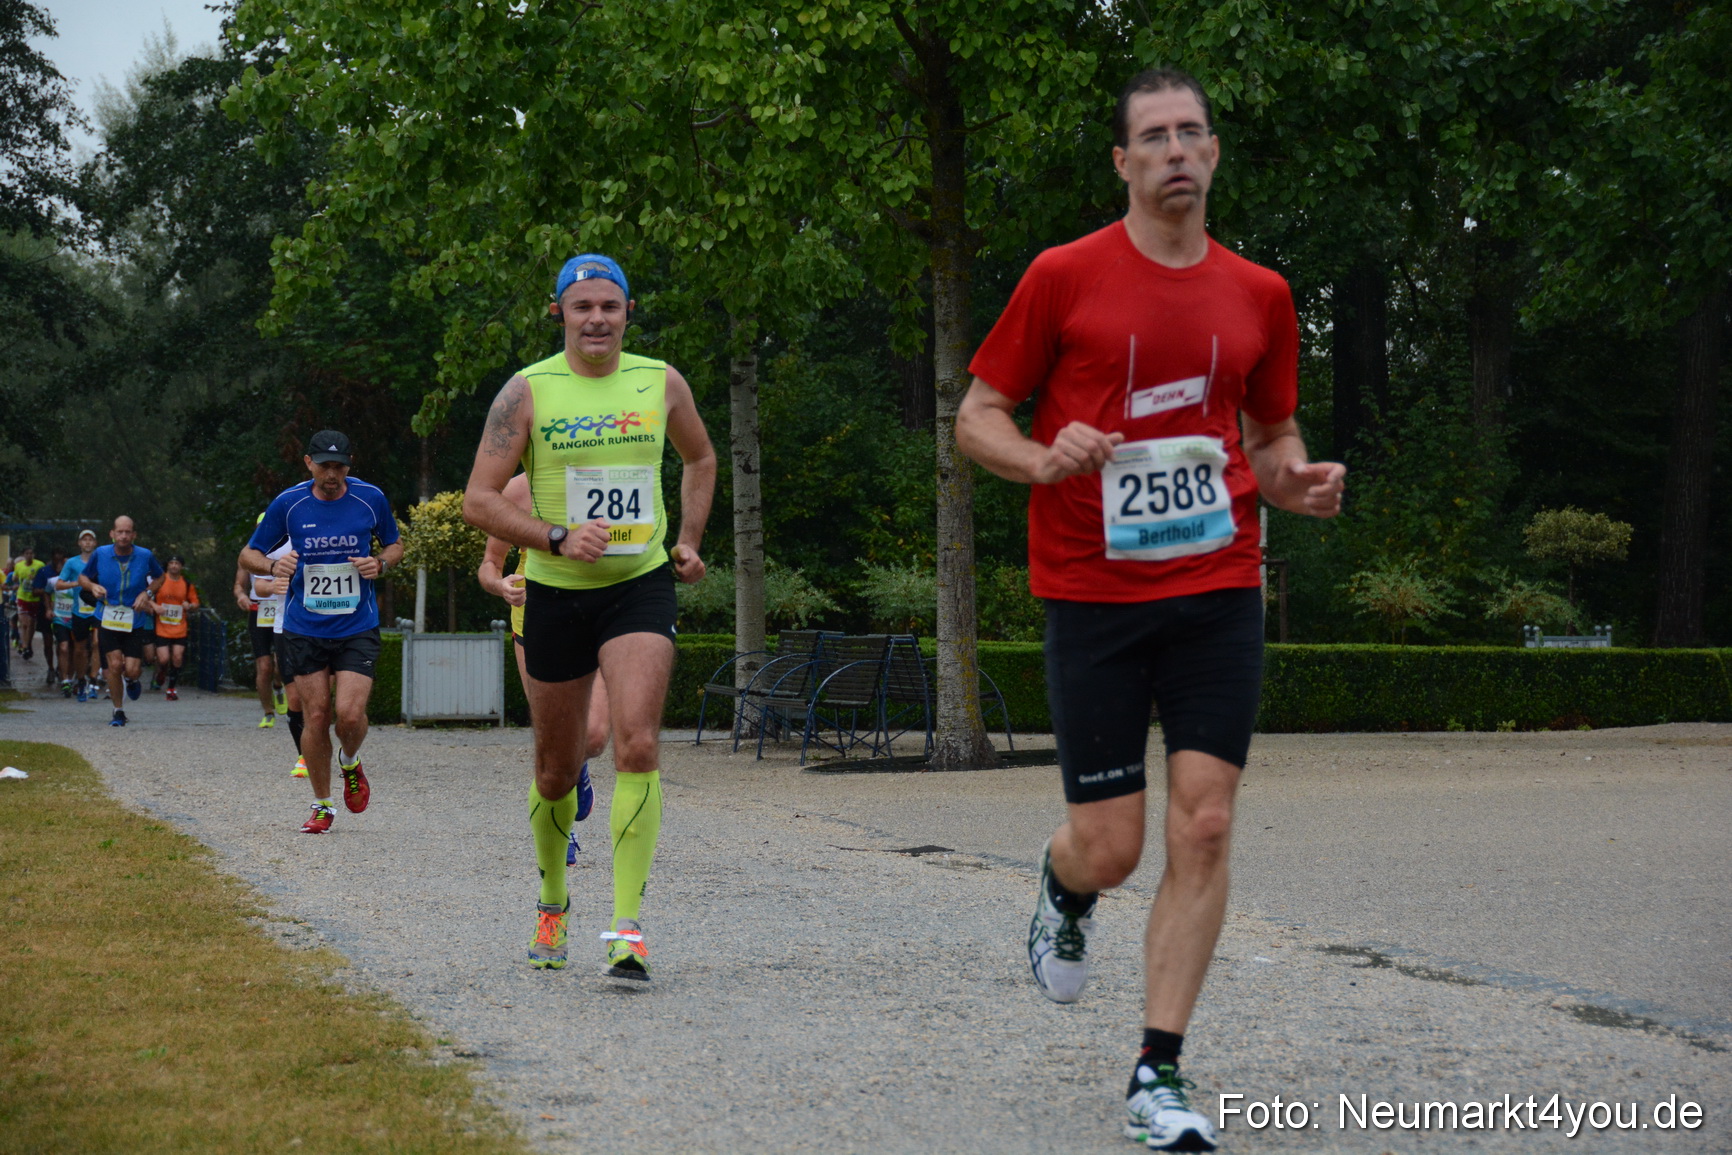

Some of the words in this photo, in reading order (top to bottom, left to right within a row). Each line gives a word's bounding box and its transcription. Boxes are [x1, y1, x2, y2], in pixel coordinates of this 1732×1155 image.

[552, 438, 605, 451] BANGKOK
[608, 434, 656, 445] RUNNERS
[608, 469, 649, 480] BOCK
[1118, 463, 1217, 517] 2588
[586, 488, 641, 520] 284
[1138, 519, 1206, 546] Berthold
[304, 535, 358, 549] SYSCAD
[310, 574, 353, 595] 2211
[315, 599, 350, 609] Wolfgang
[112, 610, 125, 621] 77
